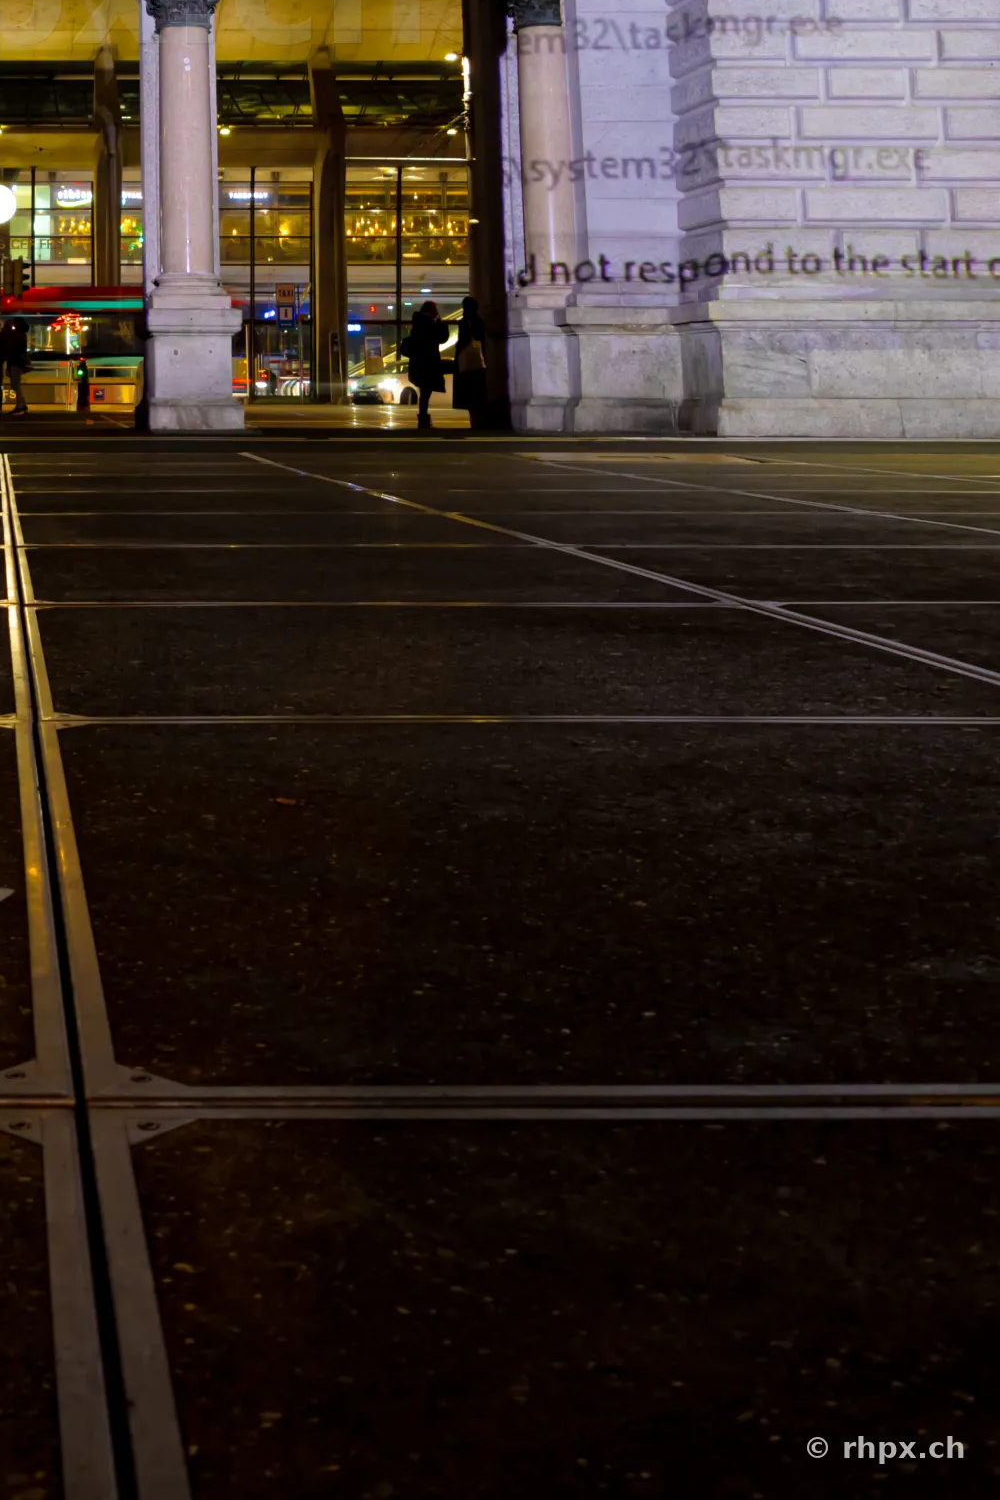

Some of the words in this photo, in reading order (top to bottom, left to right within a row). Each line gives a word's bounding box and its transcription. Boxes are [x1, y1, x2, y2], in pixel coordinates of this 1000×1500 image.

[550, 252, 612, 285] not
[623, 241, 774, 291] respond
[786, 248, 823, 276] to
[833, 244, 892, 279] the
[901, 248, 978, 280] start
[278, 289, 294, 297] TAXI
